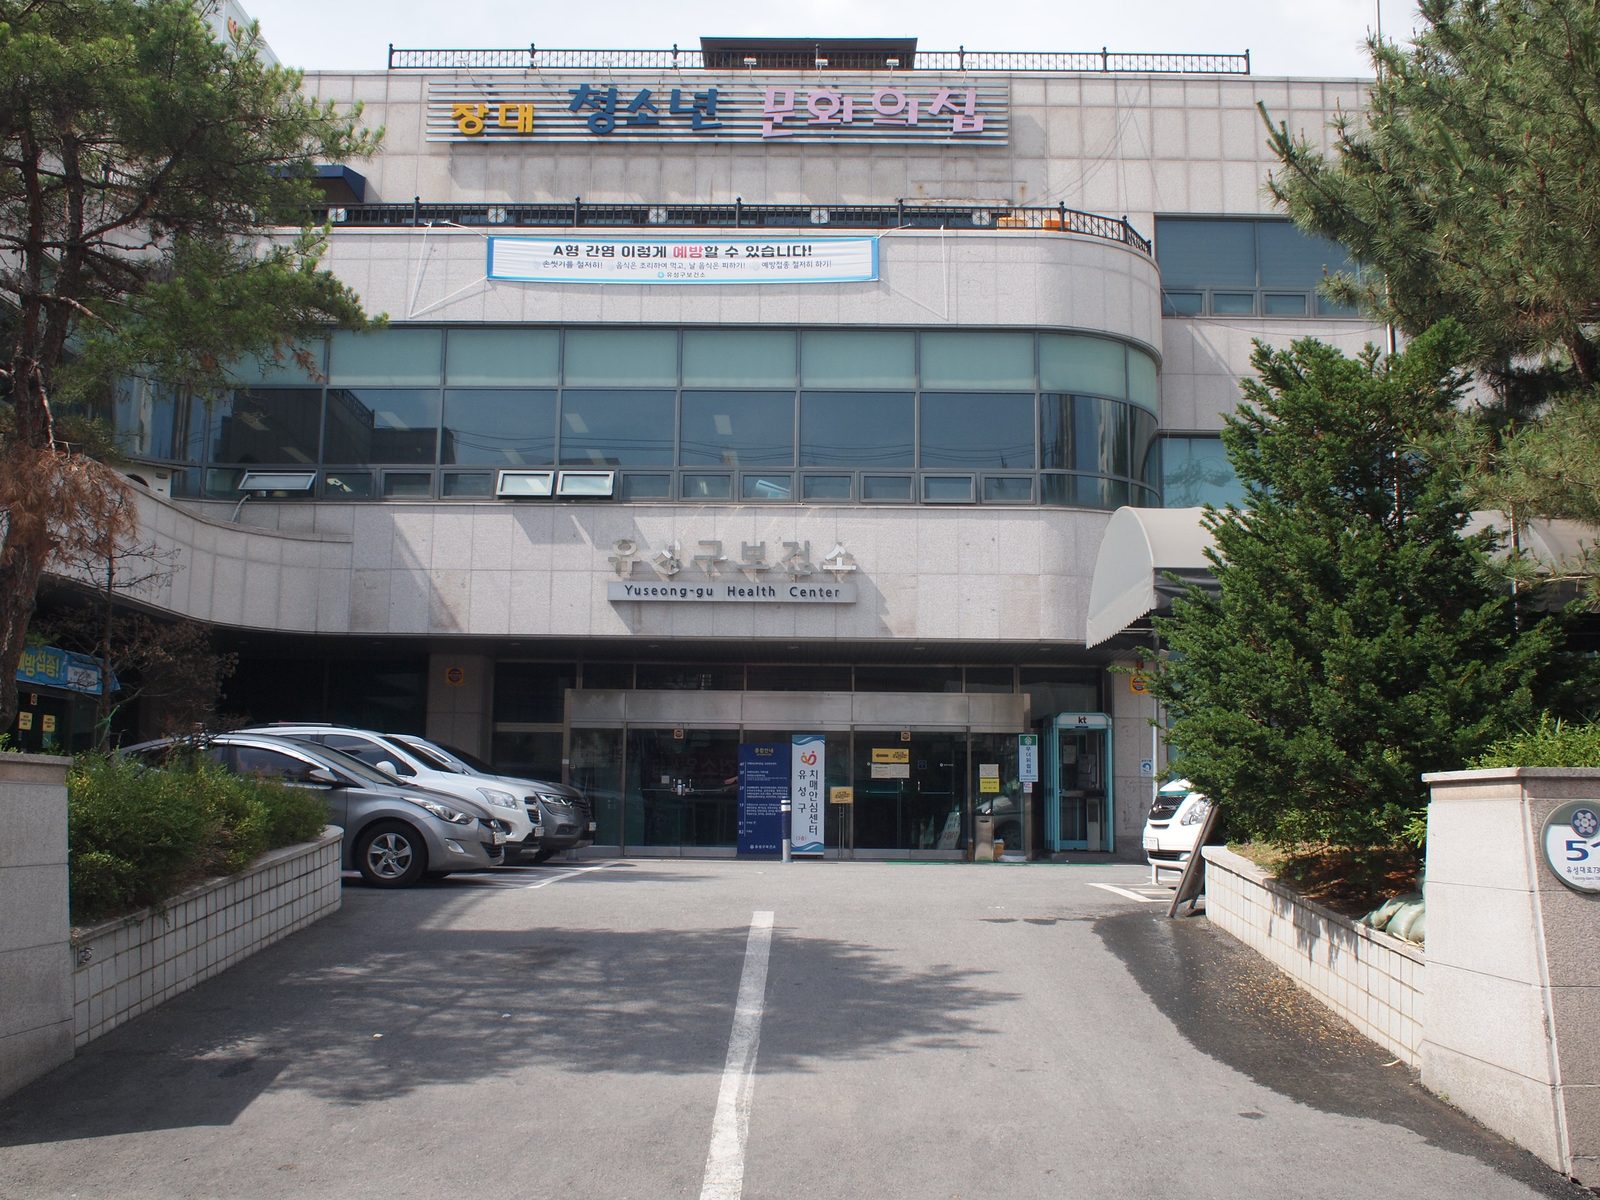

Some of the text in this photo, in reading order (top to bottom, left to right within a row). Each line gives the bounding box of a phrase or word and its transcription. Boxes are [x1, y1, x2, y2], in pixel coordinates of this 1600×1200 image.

[451, 83, 984, 138] 장대 청소년 문화의집
[553, 244, 812, 258] A형 간염 이렇게 예방할 수 있습니다!
[542, 260, 603, 269] 손씻기를 철저히!
[616, 261, 746, 270] 음식은 조리하여 먹고, 날 음식은 피하기!
[761, 260, 790, 269] 예방접종
[793, 260, 813, 269] 철저히
[607, 538, 857, 577] 유성구보건소
[624, 584, 840, 599] Yuseong-gu Health Center
[1078, 716, 1087, 724] kt
[797, 769, 807, 813] 유성구
[808, 769, 819, 836] 치매안심센터
